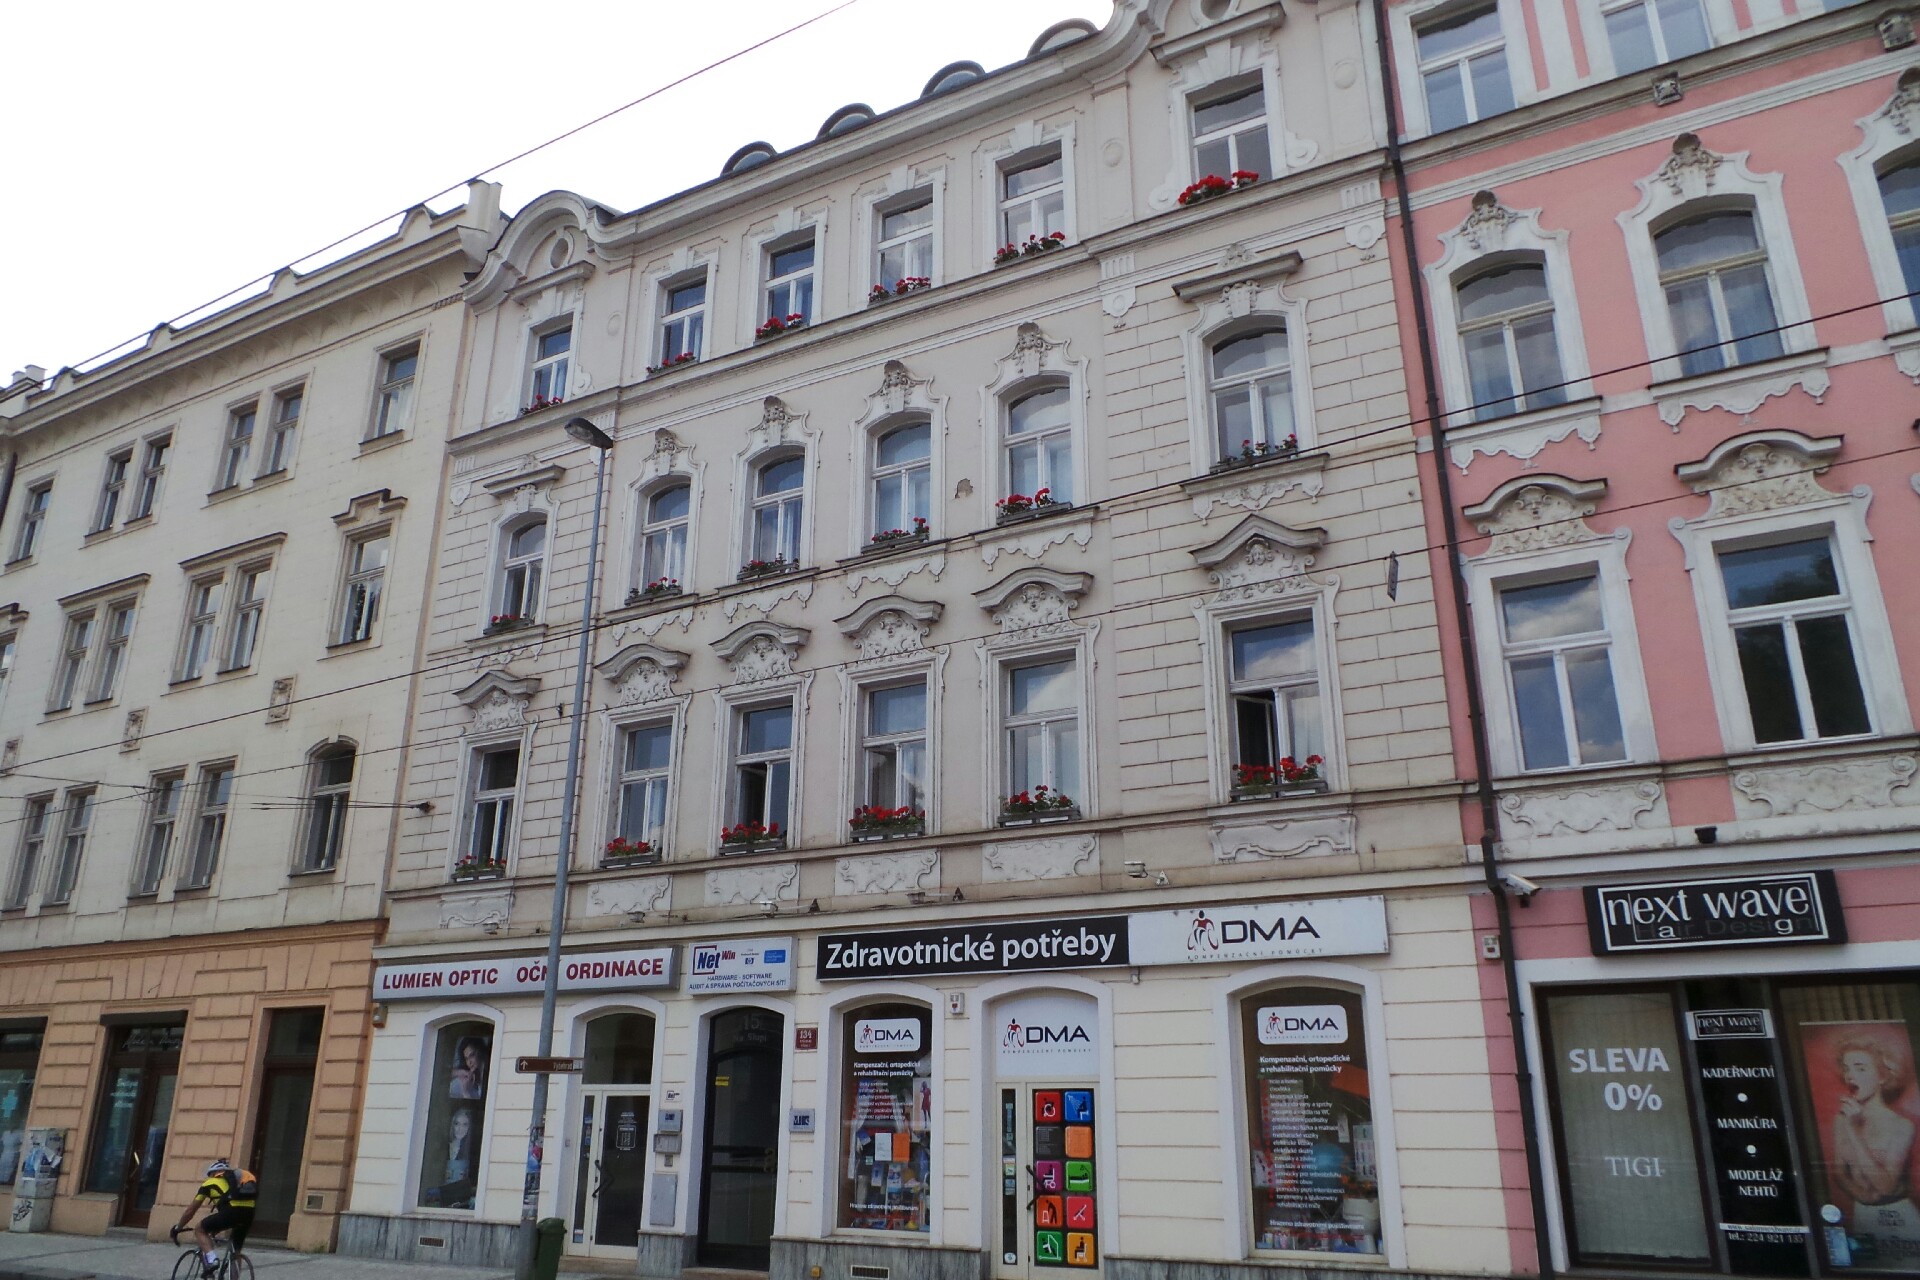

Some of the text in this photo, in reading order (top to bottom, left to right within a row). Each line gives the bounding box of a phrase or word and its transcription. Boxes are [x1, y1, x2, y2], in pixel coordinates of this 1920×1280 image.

[1607, 886, 1810, 926] next wave
[1221, 915, 1321, 944] DMA
[825, 926, 1117, 969] Zdravotnické potřeby
[696, 950, 736, 970] Net Win
[382, 971, 443, 990] LUMIEN
[448, 967, 499, 987] OPTIC
[566, 958, 664, 981] ORDINACE
[742, 972, 772, 980] SOFTWARE
[710, 981, 732, 989] SPRÁVA
[732, 979, 775, 988] POČÍTAČOVÝCH
[1284, 1017, 1339, 1031] DMA
[1697, 1016, 1760, 1028] next wave
[799, 1030, 812, 1039] 134
[874, 1028, 914, 1041] DMA
[1026, 1025, 1090, 1043] DMA
[1260, 1054, 1350, 1064] Kompenzační, ortopedické
[1568, 1047, 1670, 1073] SLEVA
[1266, 1064, 1309, 1073] rehabilitační
[1309, 1064, 1342, 1074] pomůcky
[1702, 1064, 1775, 1079] KADEŘNICTVÍ
[1604, 1081, 1663, 1111] 0%
[1717, 1115, 1778, 1129] MANIKÚRA
[1604, 1156, 1663, 1178] TIGI
[1728, 1167, 1784, 1181] MODELÁŽ
[1739, 1184, 1779, 1197] NEHTŮ
